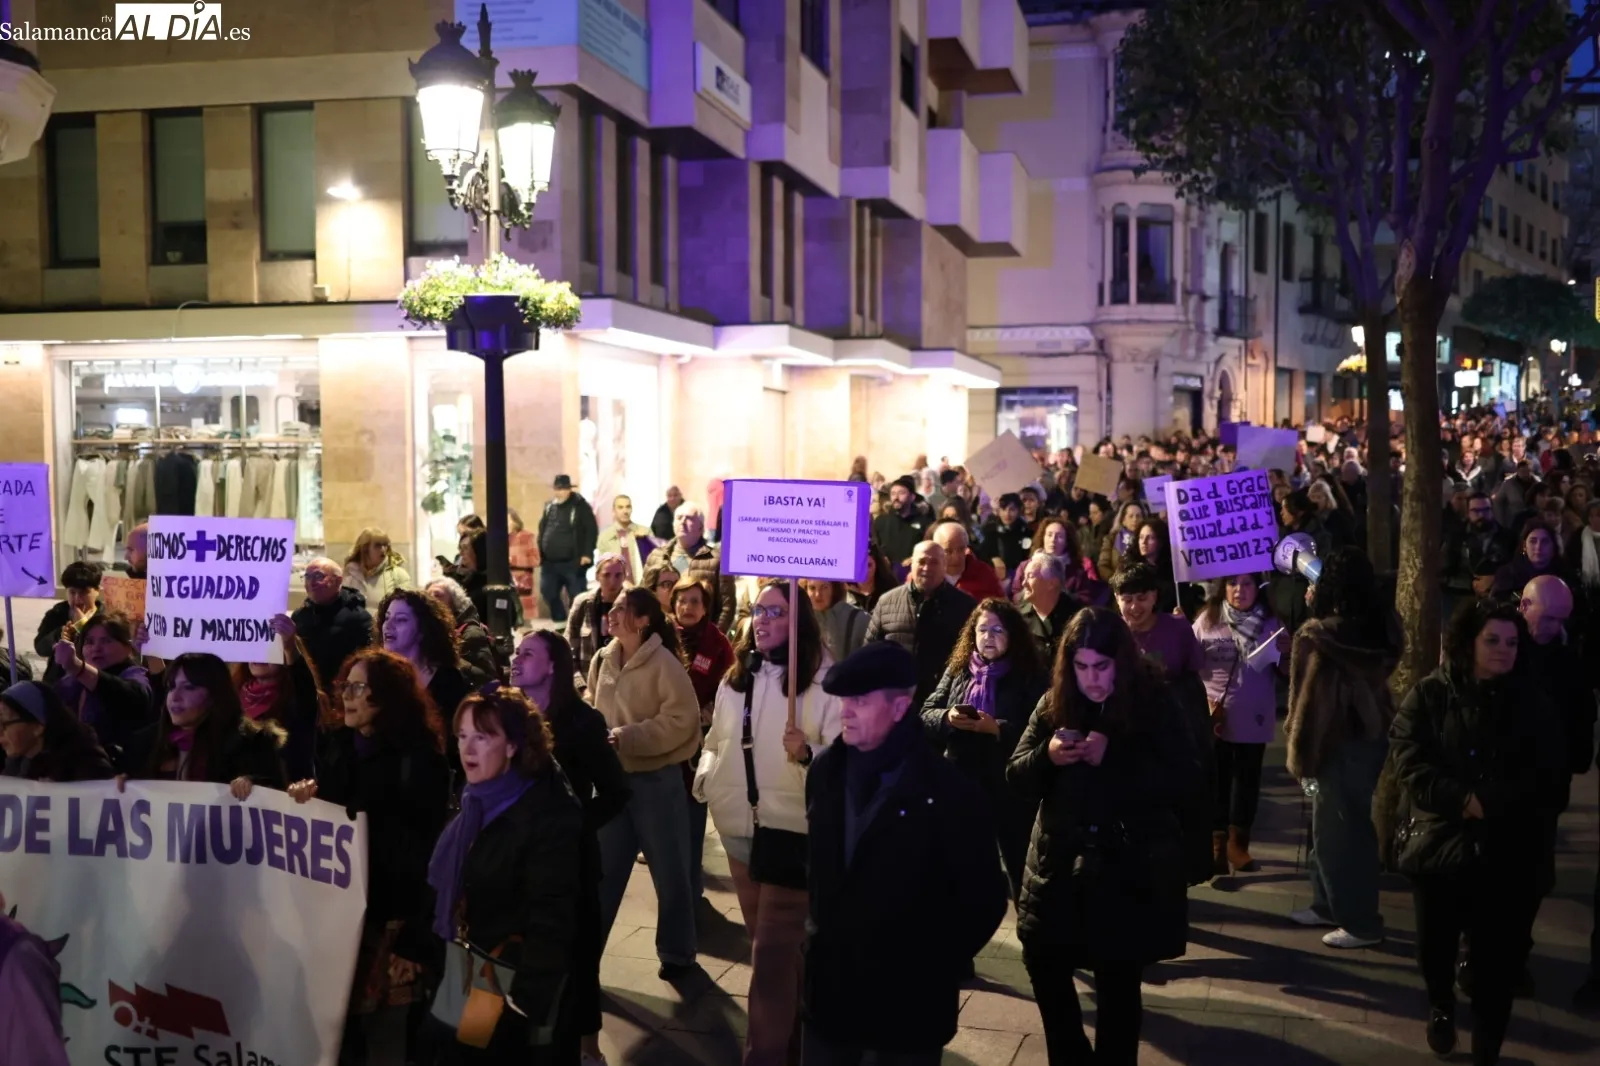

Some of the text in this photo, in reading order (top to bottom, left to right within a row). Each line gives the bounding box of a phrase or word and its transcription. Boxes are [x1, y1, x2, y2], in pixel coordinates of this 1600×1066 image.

[0, 479, 36, 496] ADA
[763, 495, 826, 508] ¡BASTA YA!
[757, 526, 791, 534] MACHISMO
[762, 517, 800, 525] PERSEGUIDA
[215, 533, 288, 562] DERECHOS
[747, 554, 838, 567] ¡NO NOS CALLARÁN!
[151, 575, 261, 600] EN IGUALDAD
[173, 616, 193, 638] EN
[0, 794, 355, 889] DE LAS MUJERES
[193, 1041, 280, 1066] Salam
